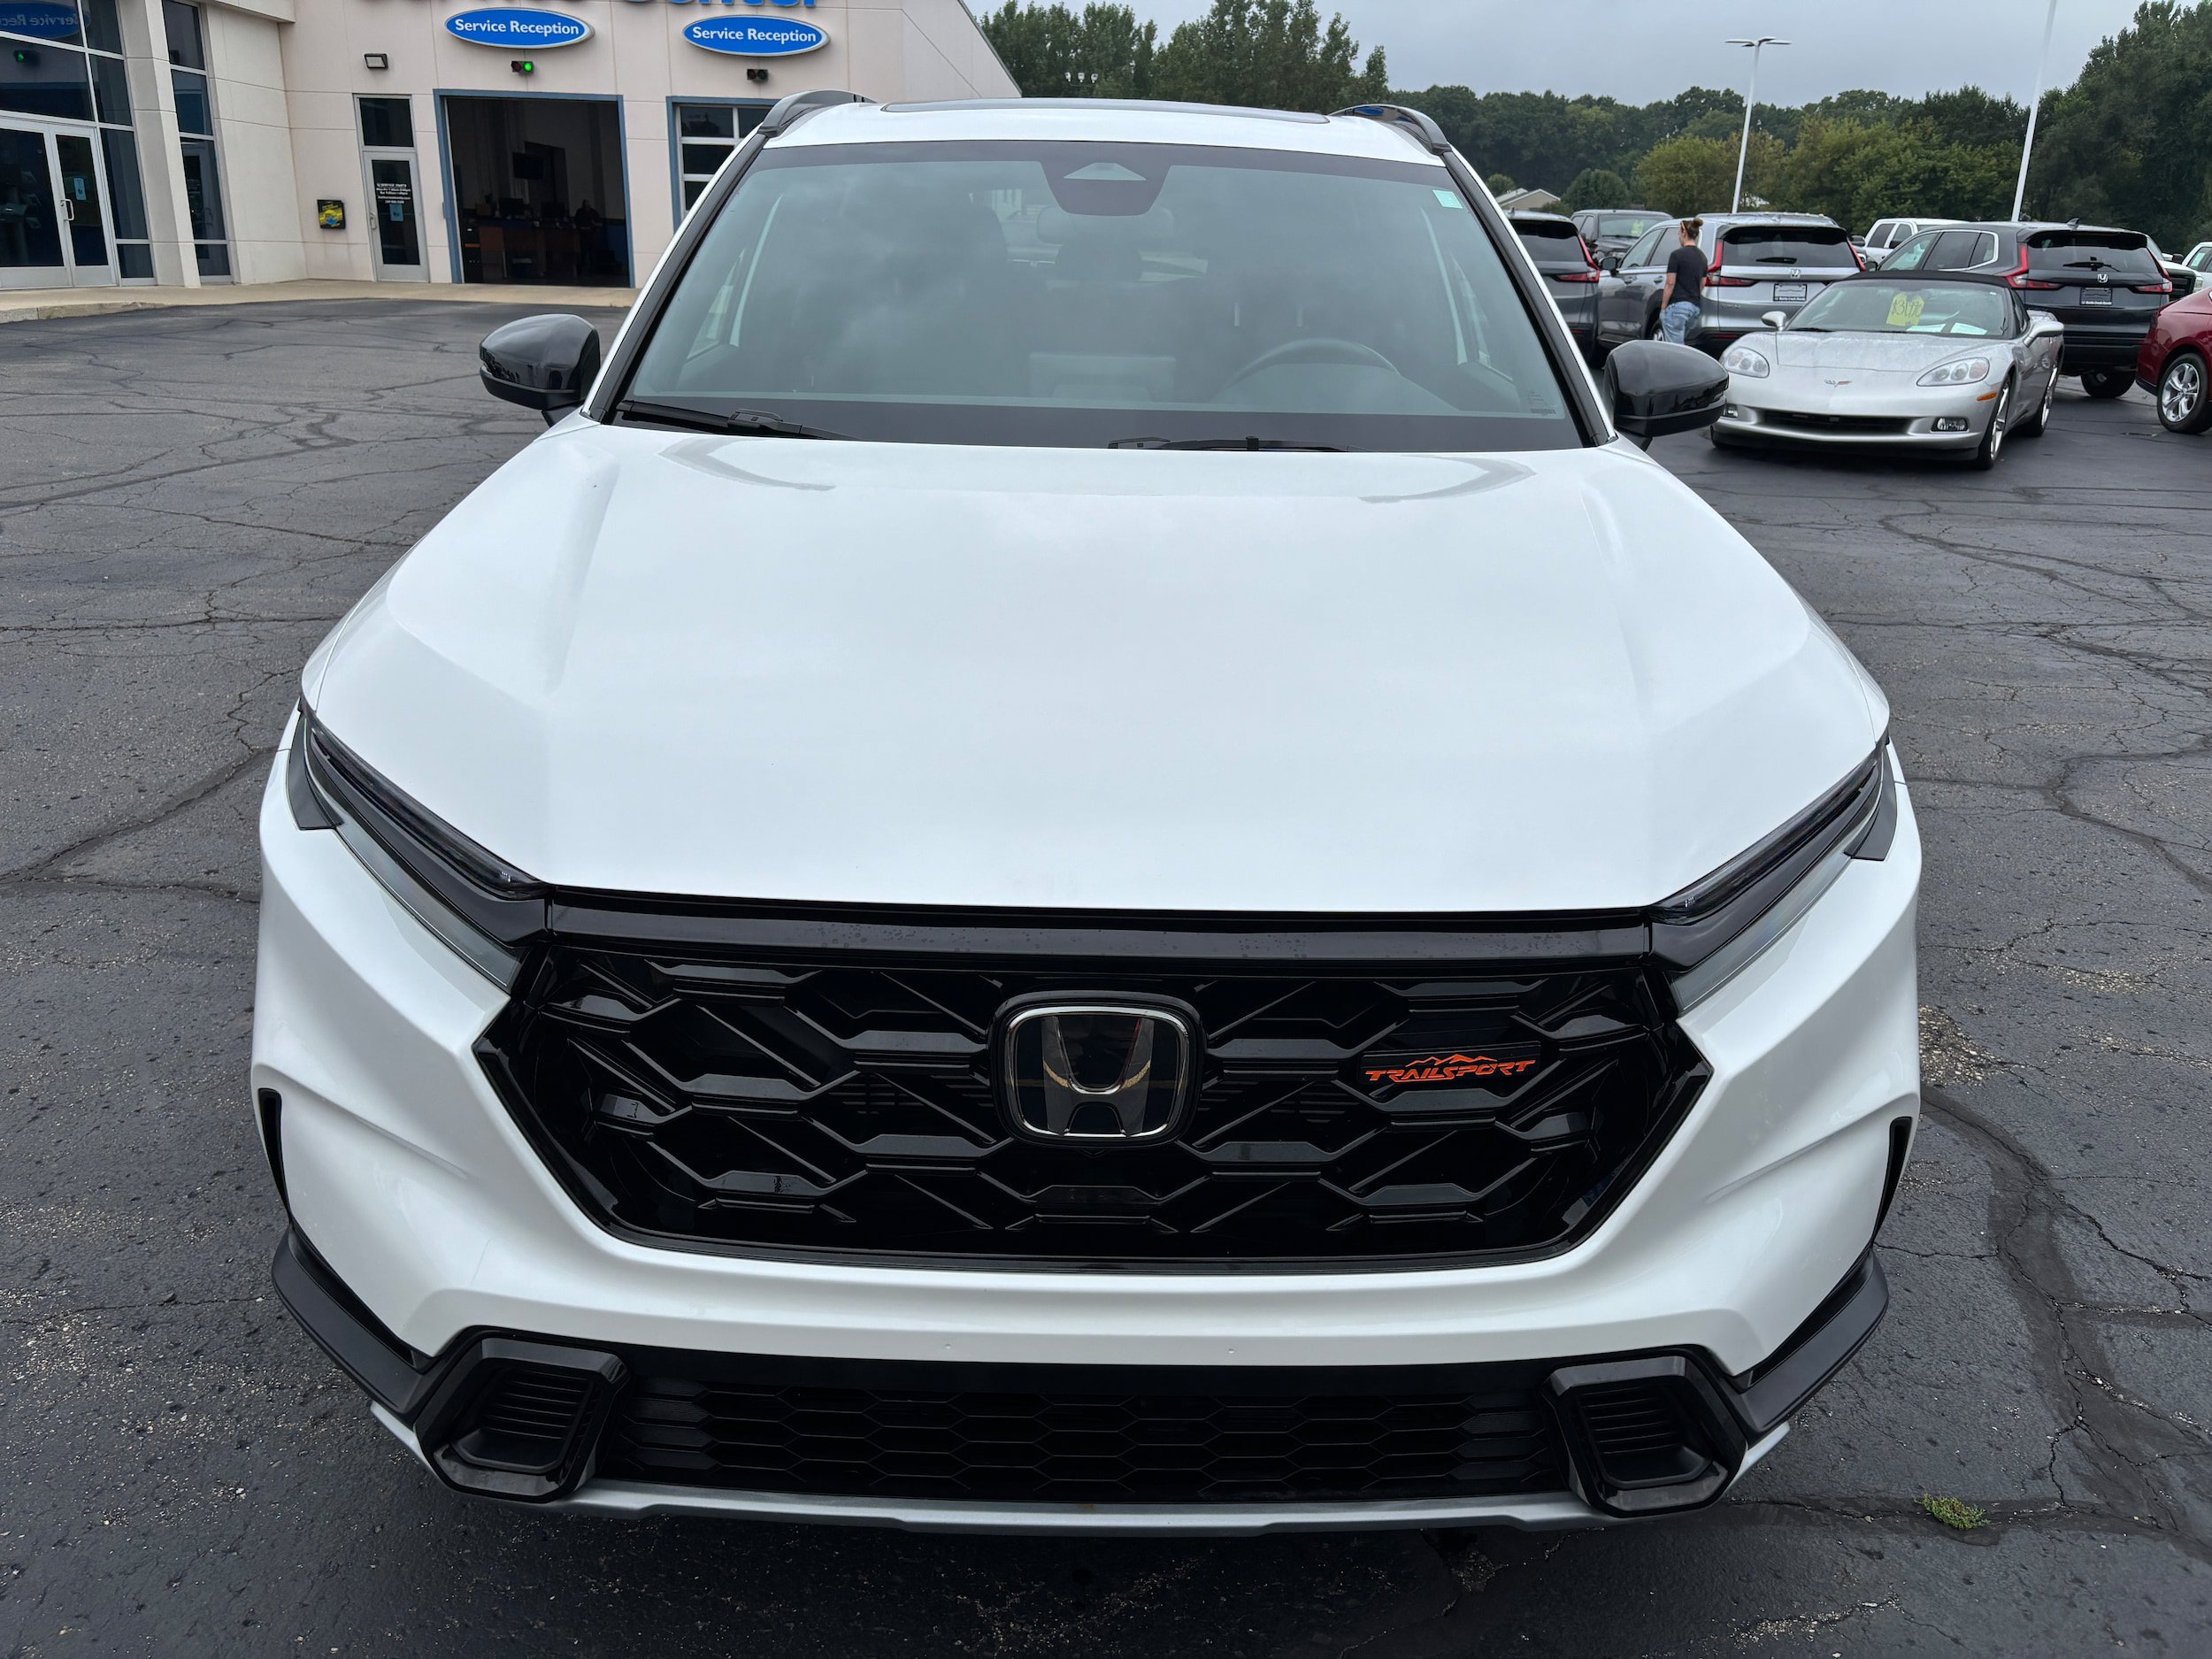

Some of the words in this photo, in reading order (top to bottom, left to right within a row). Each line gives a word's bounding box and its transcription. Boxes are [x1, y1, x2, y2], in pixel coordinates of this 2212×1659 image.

[455, 19, 507, 33] Service
[510, 20, 580, 37] Reception
[692, 27, 744, 41] Service
[747, 27, 817, 44] Reception
[1365, 1060, 1536, 1082] TRAILSPORT
